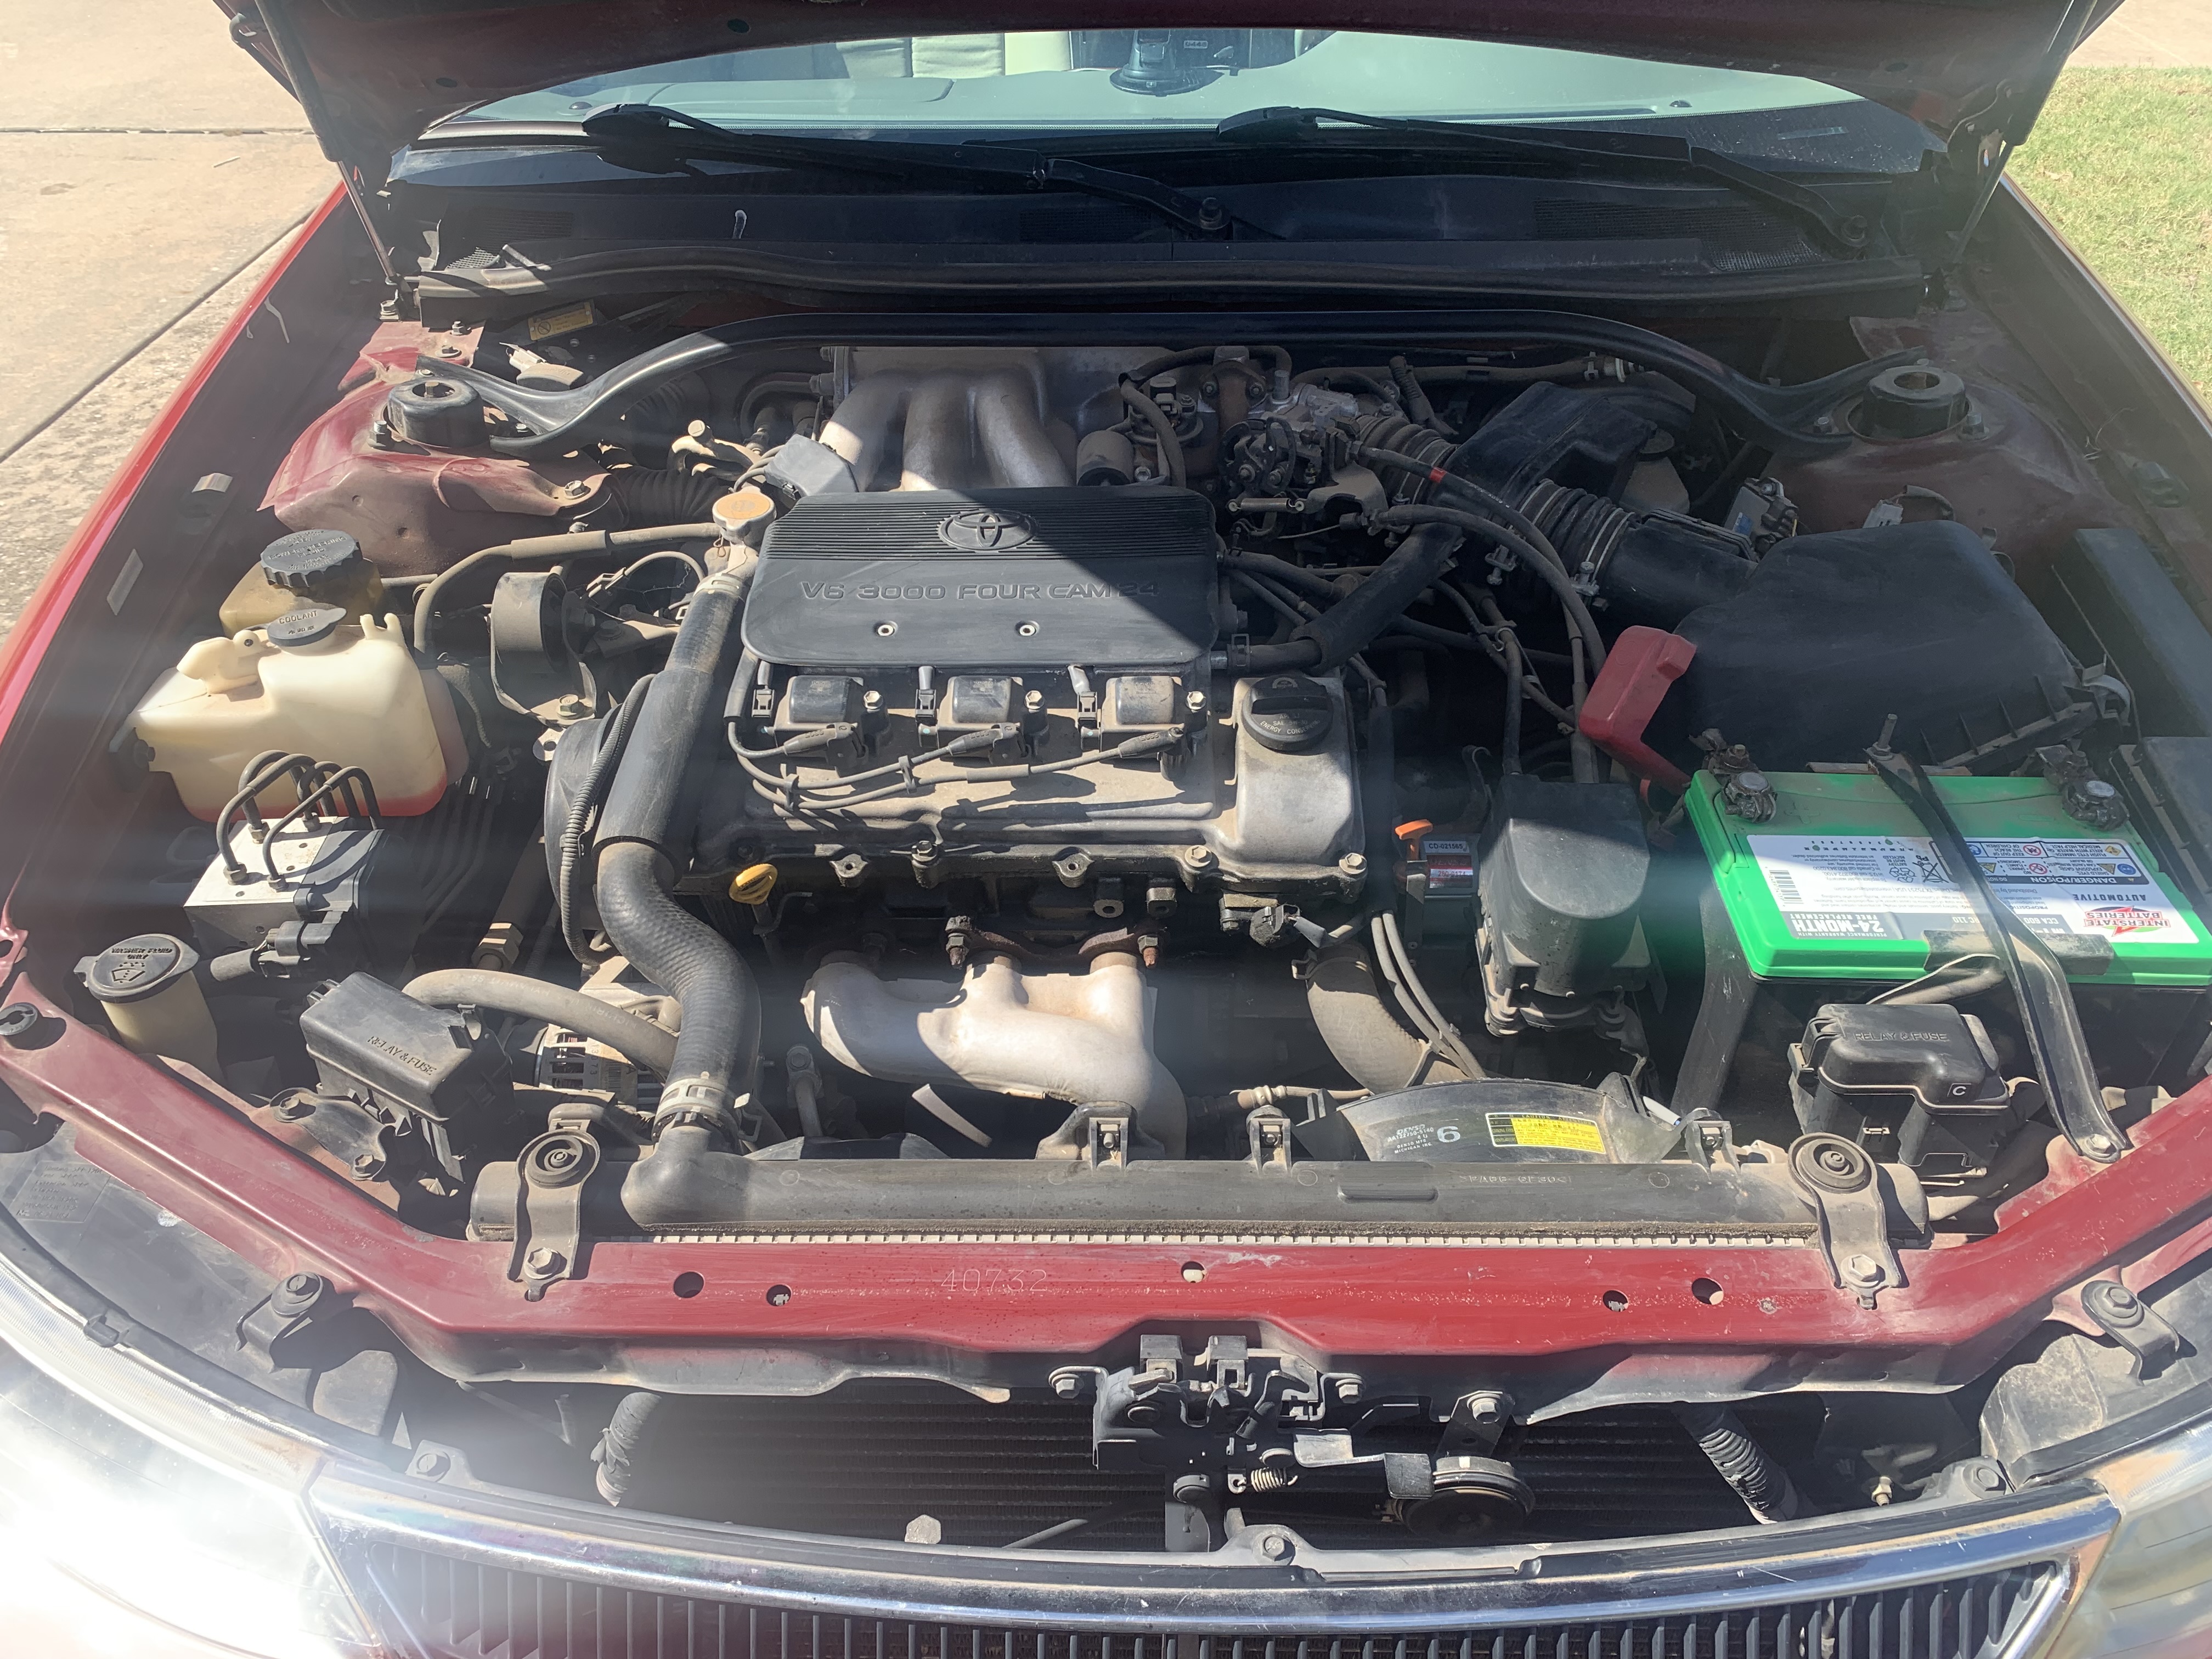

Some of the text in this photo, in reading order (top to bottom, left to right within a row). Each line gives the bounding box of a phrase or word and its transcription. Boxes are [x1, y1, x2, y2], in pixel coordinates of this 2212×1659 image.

[268, 548, 301, 560] POWER
[303, 537, 347, 550] STEERING
[297, 548, 325, 558] FLUID
[801, 582, 1159, 600] V6 3000 FOUR CAM 24
[279, 610, 317, 624] COOLANT
[1260, 720, 1282, 733] ENERGY
[1792, 919, 1884, 933] 24-MONTH
[1853, 1032, 1949, 1041] RELAY & FUSE
[368, 1036, 403, 1056] RELAY
[407, 1057, 437, 1075] FUSE
[1953, 1086, 1967, 1096] C
[1396, 1124, 1425, 1134] DENSO
[1437, 1126, 1460, 1143] 6
[1395, 1145, 1420, 1154] MICHIGAN
[941, 1268, 1047, 1292] 40732
